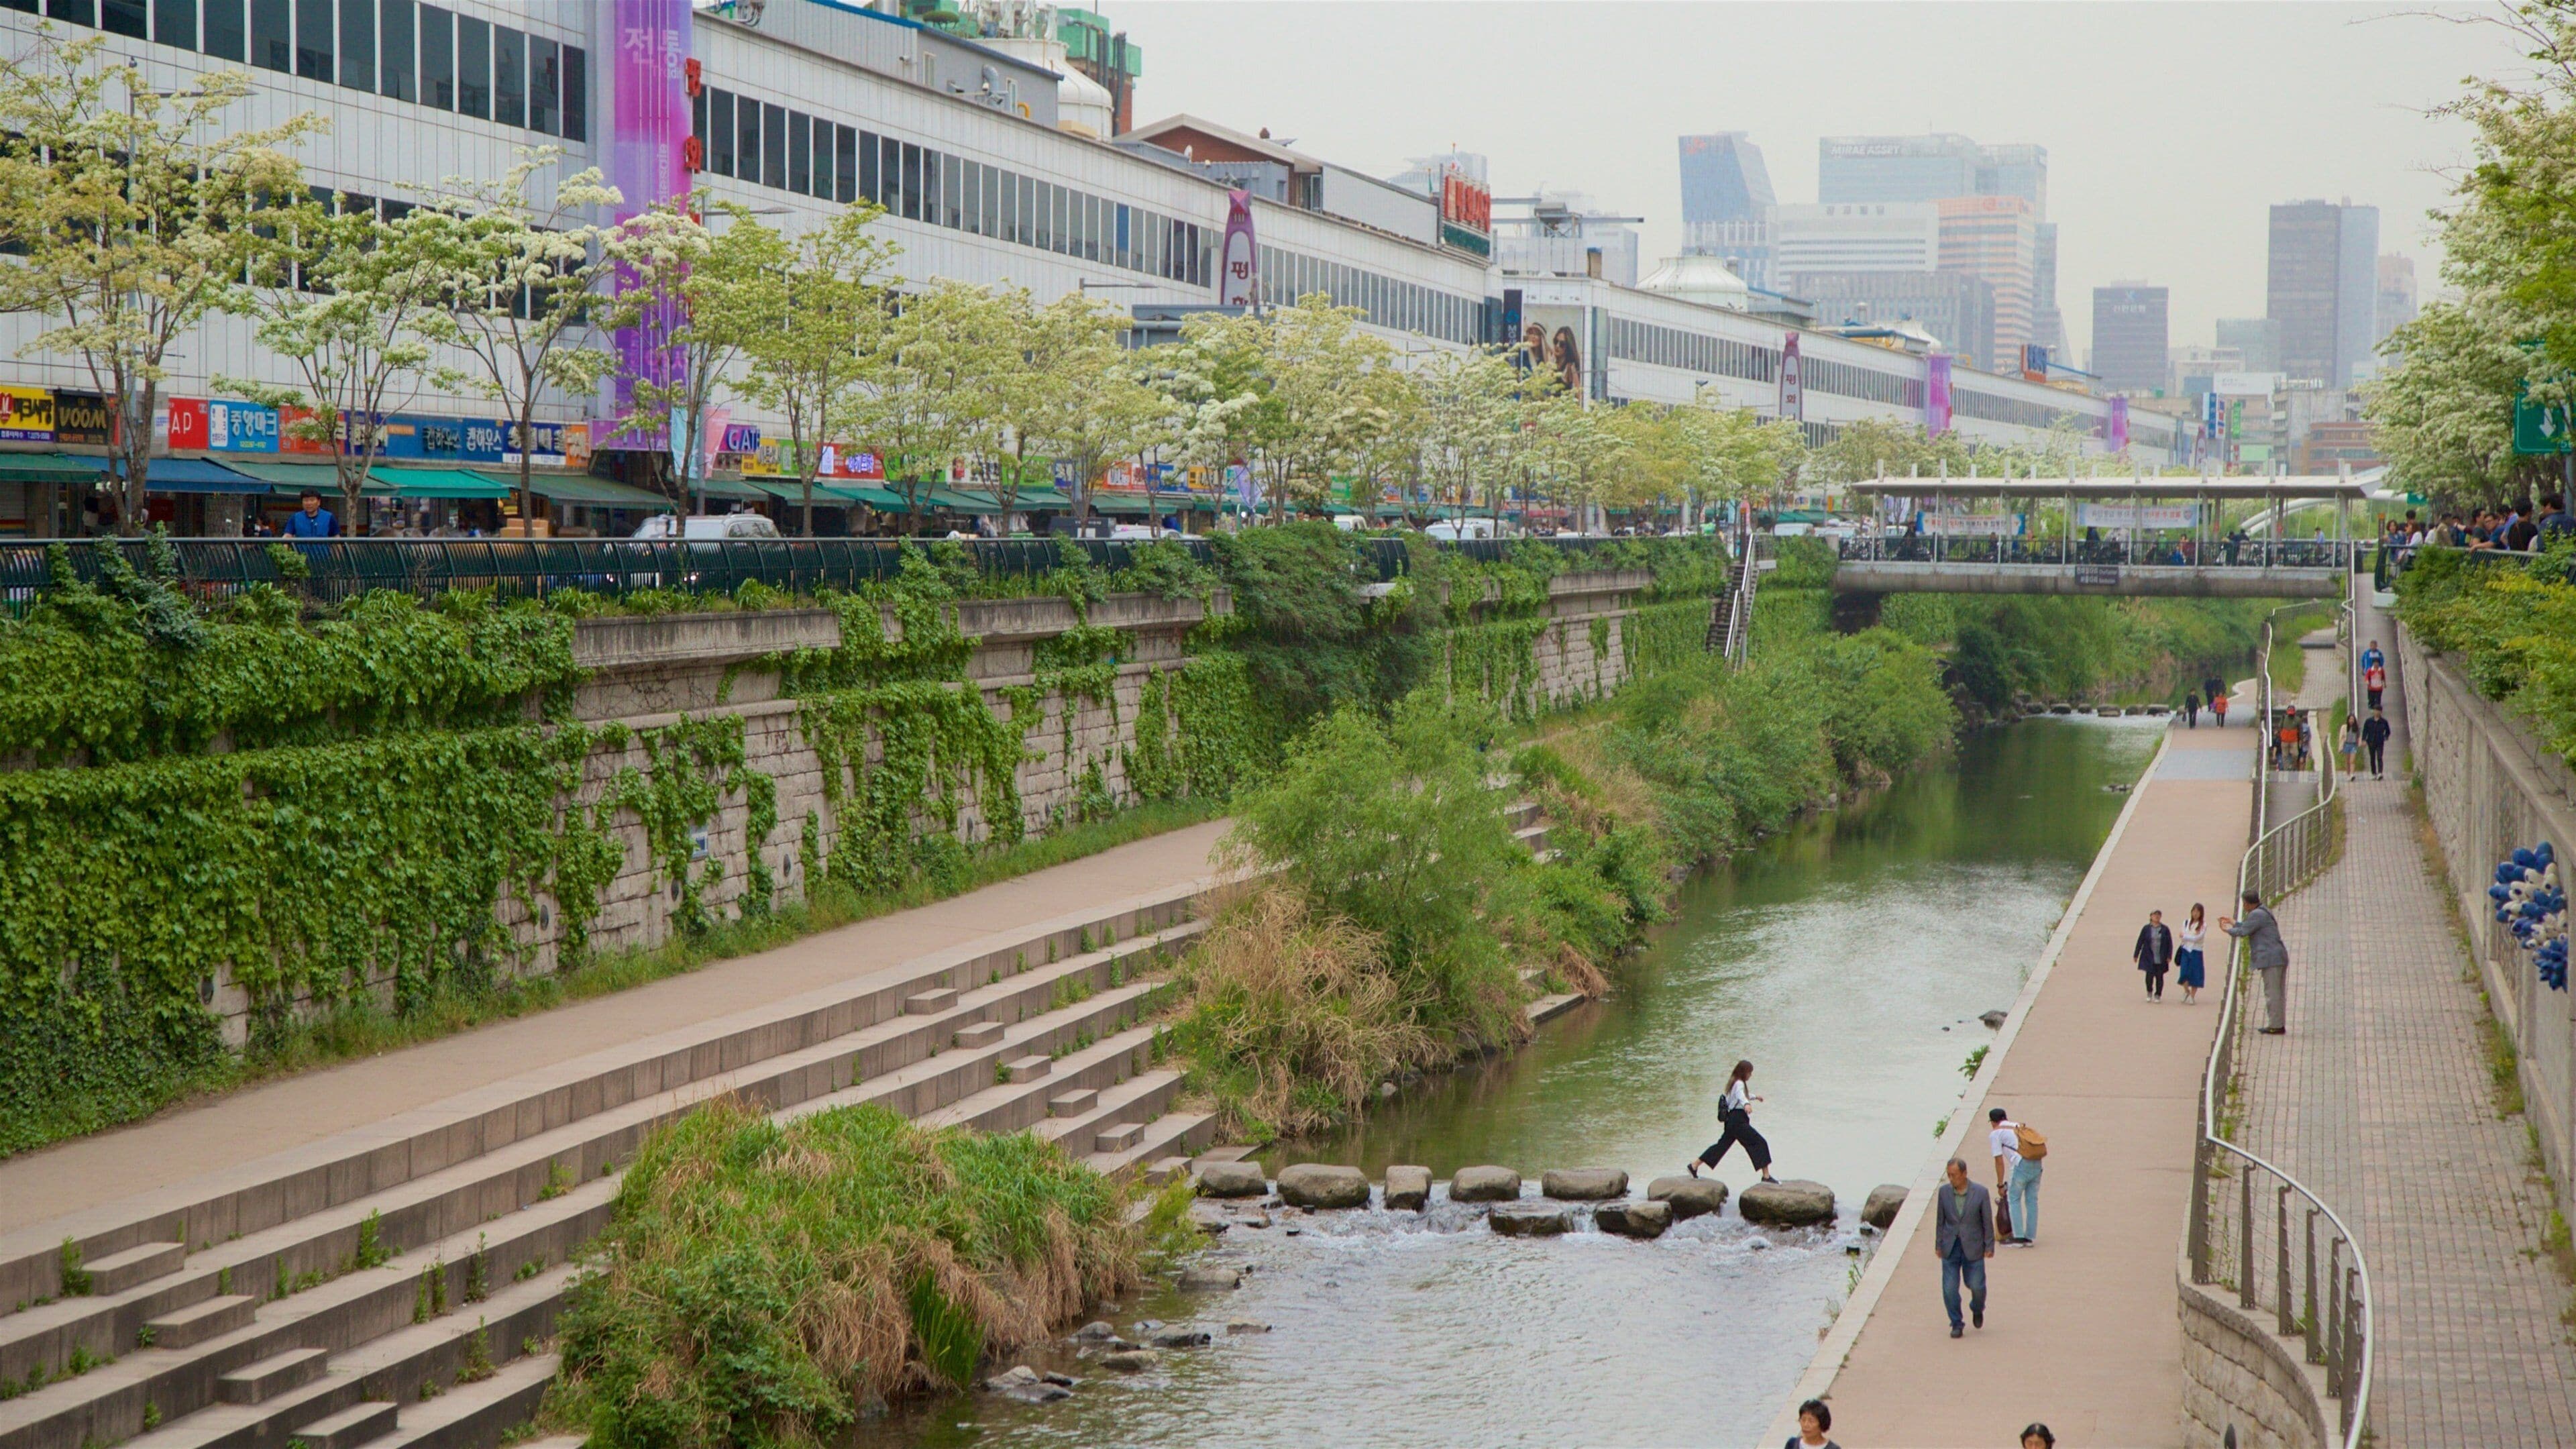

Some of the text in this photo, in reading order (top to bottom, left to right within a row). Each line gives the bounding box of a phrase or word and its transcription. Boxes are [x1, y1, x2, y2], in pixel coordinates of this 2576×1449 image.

[625, 28, 682, 66] 전통
[657, 142, 669, 204] olesale
[59, 407, 107, 429] VOOM
[169, 411, 192, 434] AP
[230, 410, 276, 437] 중앙마크
[466, 427, 502, 452] 캡하우스
